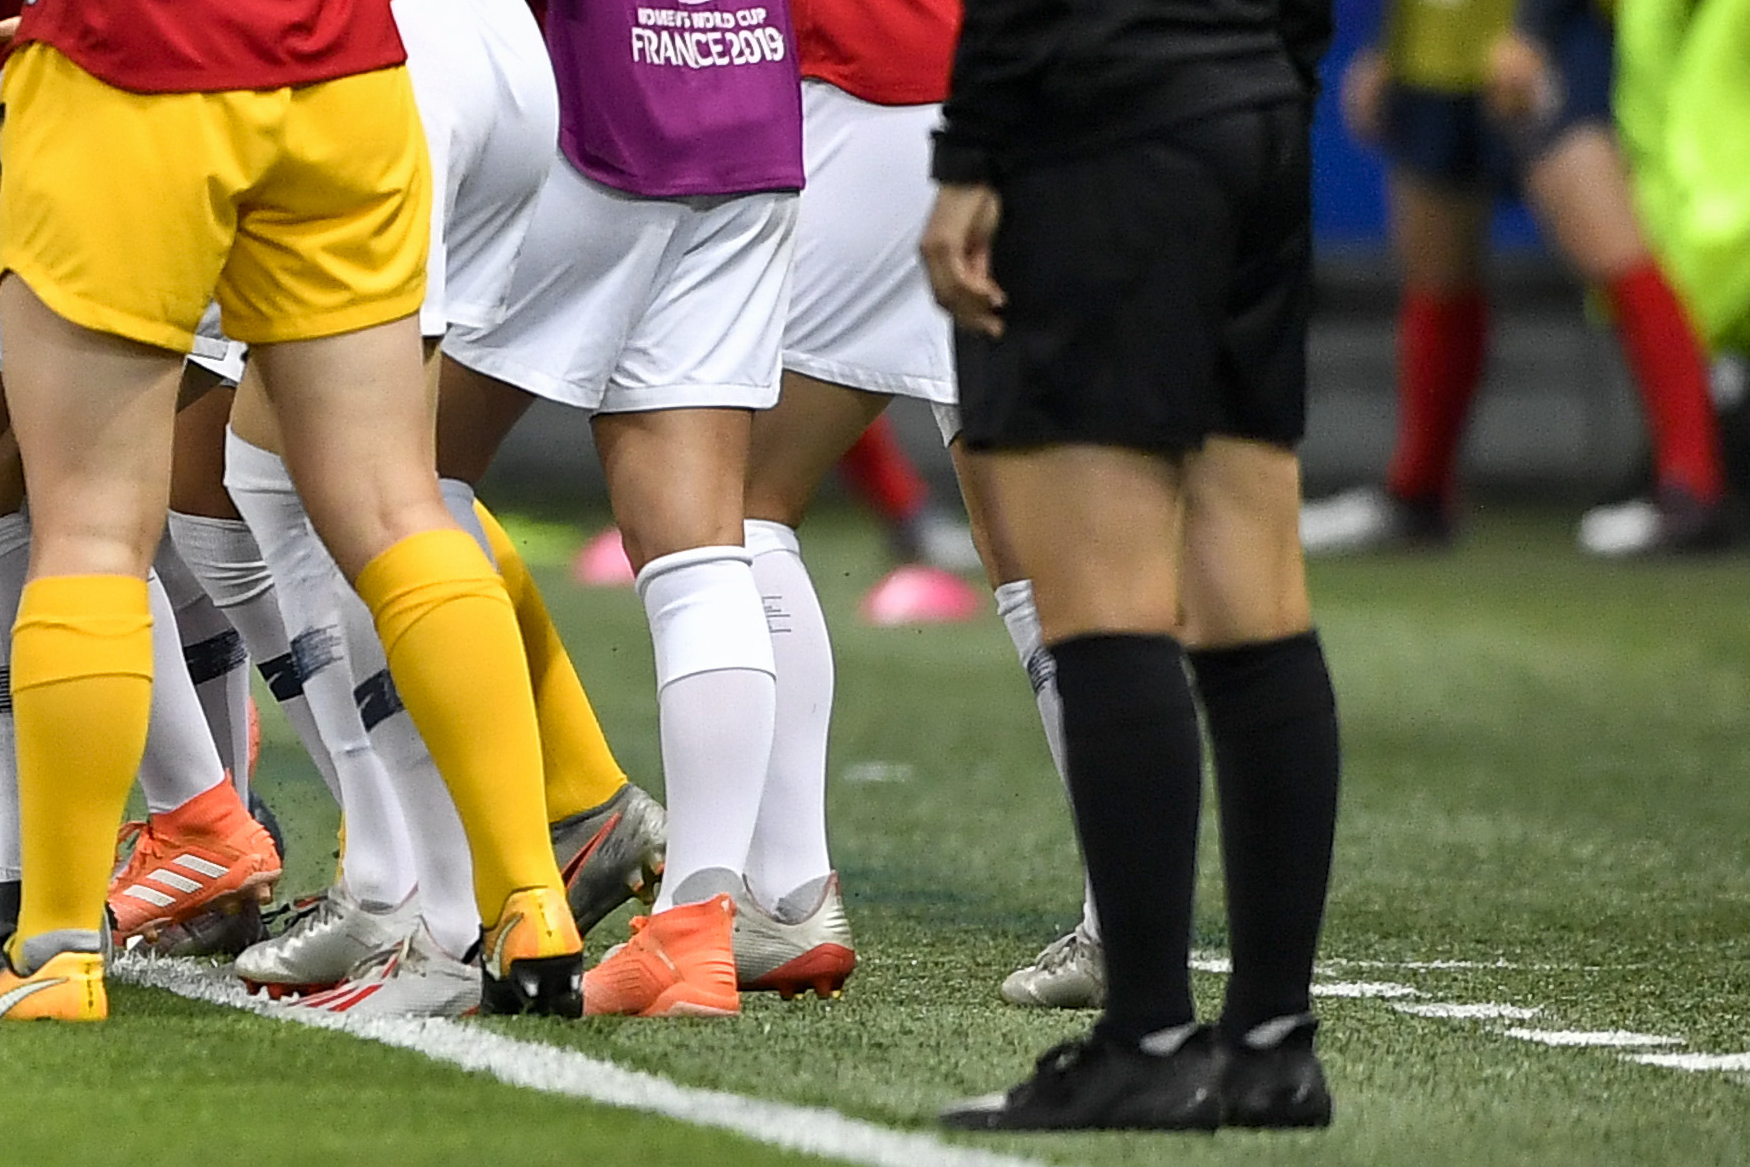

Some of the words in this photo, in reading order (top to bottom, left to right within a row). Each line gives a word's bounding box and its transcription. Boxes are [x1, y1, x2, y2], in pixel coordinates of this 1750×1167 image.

[691, 10, 736, 30] WOLD
[736, 7, 768, 27] CUP
[631, 27, 730, 70] FRANCE
[725, 26, 786, 66] 2019
